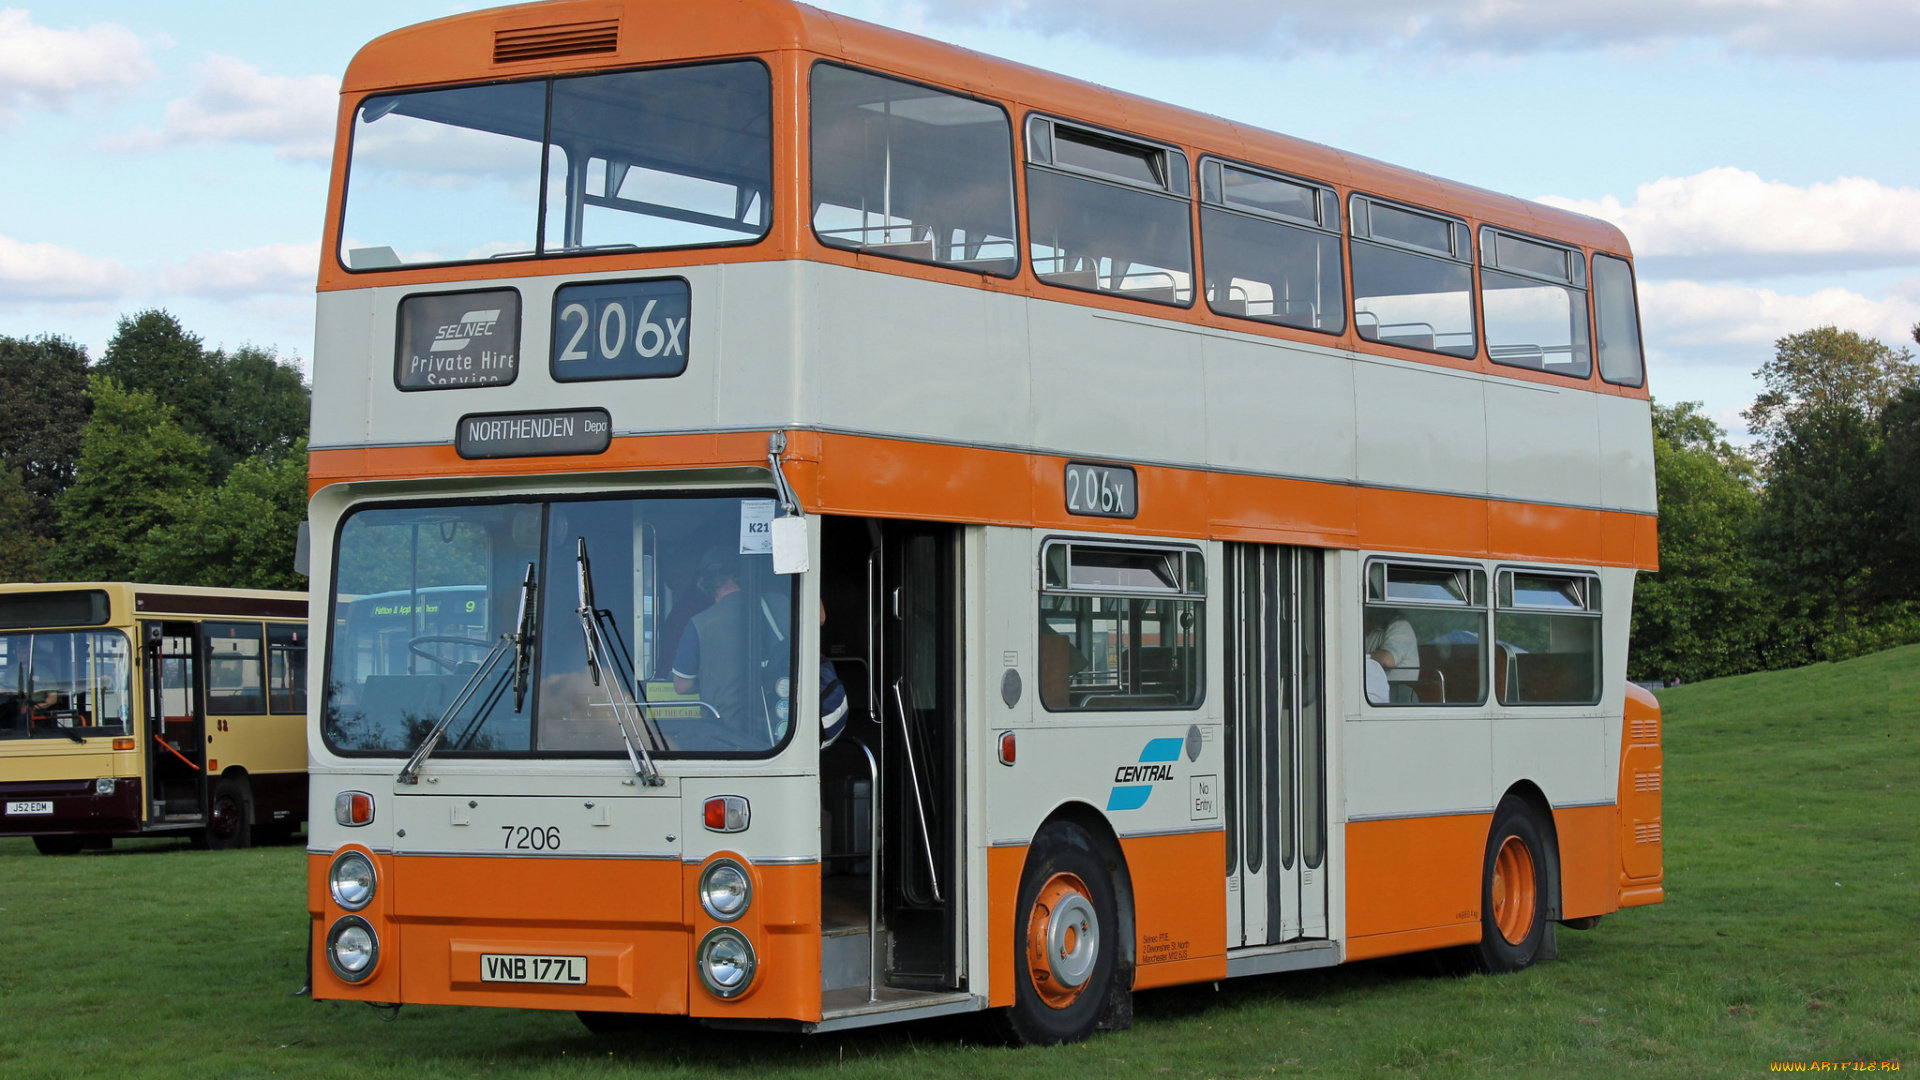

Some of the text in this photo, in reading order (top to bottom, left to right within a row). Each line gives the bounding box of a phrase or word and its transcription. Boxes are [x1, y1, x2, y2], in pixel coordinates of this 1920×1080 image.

[435, 322, 496, 339] SELNEC
[411, 350, 514, 373] Private Hire
[469, 417, 608, 441] NORTHENDEN Depo
[749, 522, 770, 533] K21
[465, 600, 476, 613] 9
[1114, 764, 1174, 783] CENTRAL
[1199, 782, 1209, 795] No
[13, 802, 47, 812] J52 EDM
[1195, 798, 1213, 813] Entry
[501, 826, 561, 850] 7206
[487, 957, 581, 981] VNB 177L
